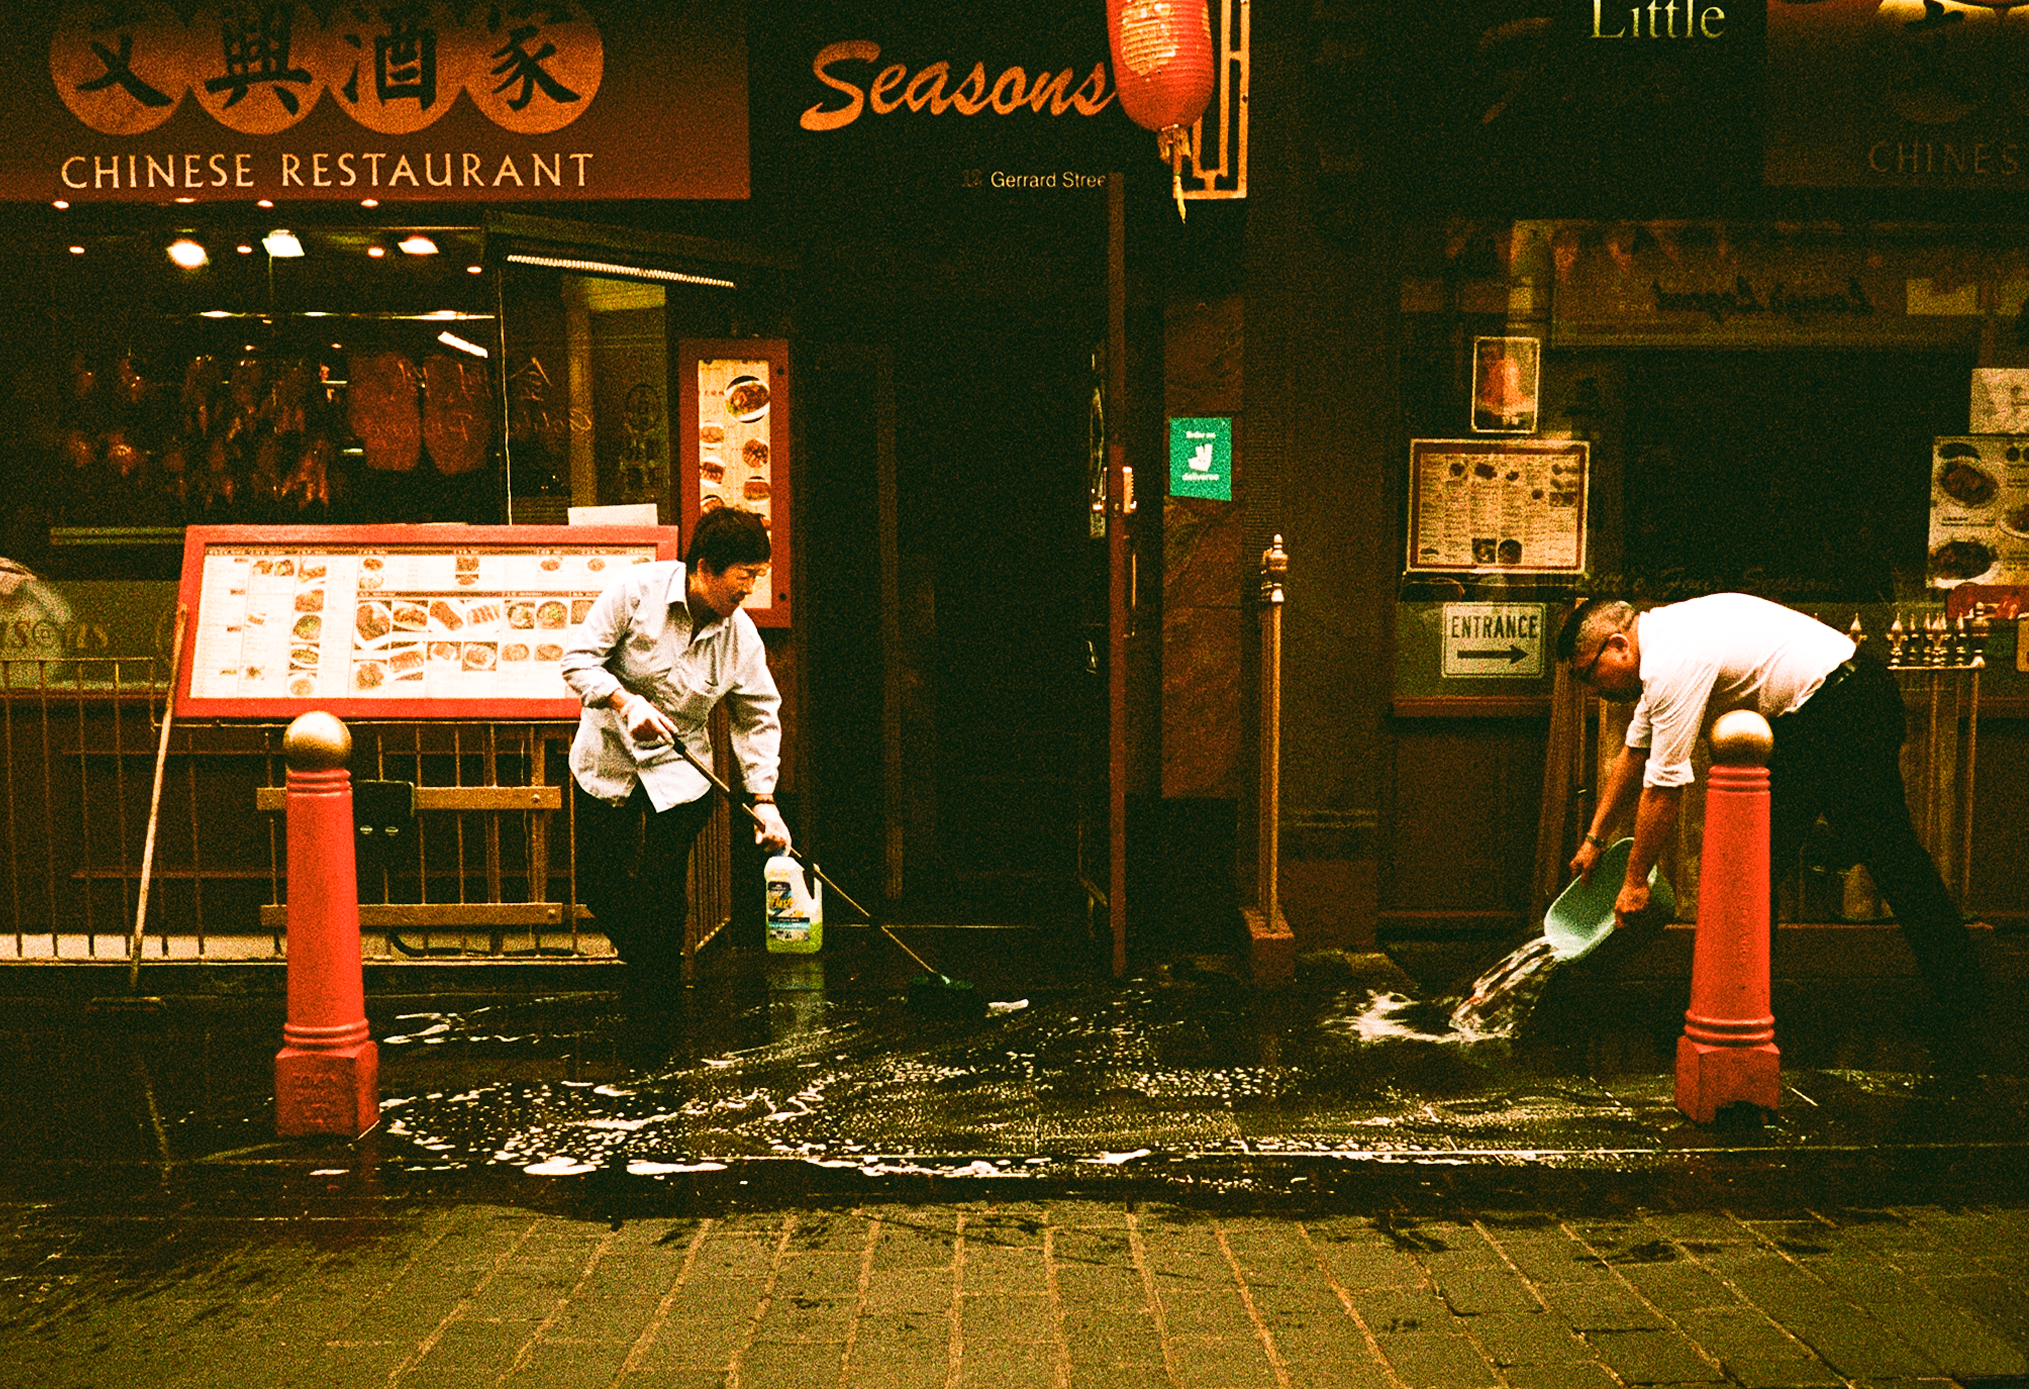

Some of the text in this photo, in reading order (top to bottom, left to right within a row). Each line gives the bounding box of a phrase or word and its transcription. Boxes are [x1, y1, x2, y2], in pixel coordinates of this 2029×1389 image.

[1590, 0, 1727, 40] Little
[800, 39, 1117, 131] Seasons
[60, 151, 595, 190] CHINESE RESTAURANT
[1867, 139, 2020, 177] CHINES
[990, 170, 1057, 189] Gerrard
[1061, 170, 1107, 189] Stree
[1450, 614, 1538, 639] ENTRANCE
